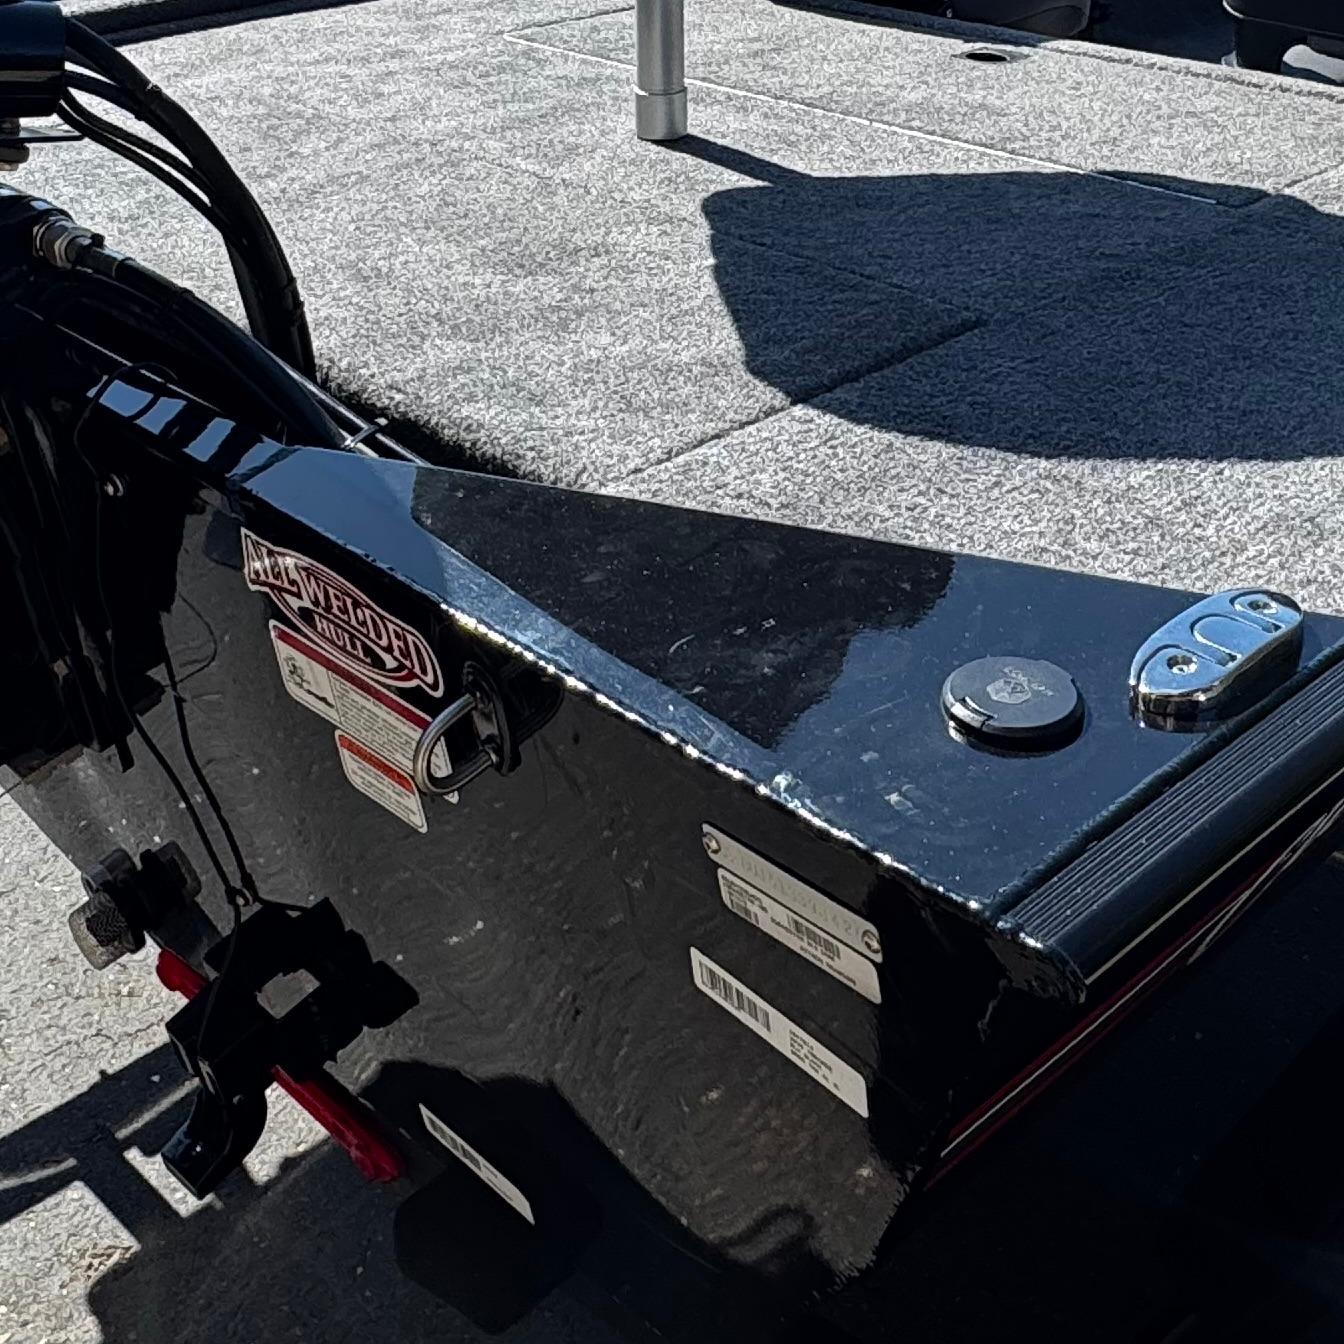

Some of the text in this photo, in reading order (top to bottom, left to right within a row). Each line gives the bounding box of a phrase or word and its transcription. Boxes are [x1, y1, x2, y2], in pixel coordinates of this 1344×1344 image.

[247, 536, 435, 686] ALL WELDED
[313, 612, 372, 664] HULL
